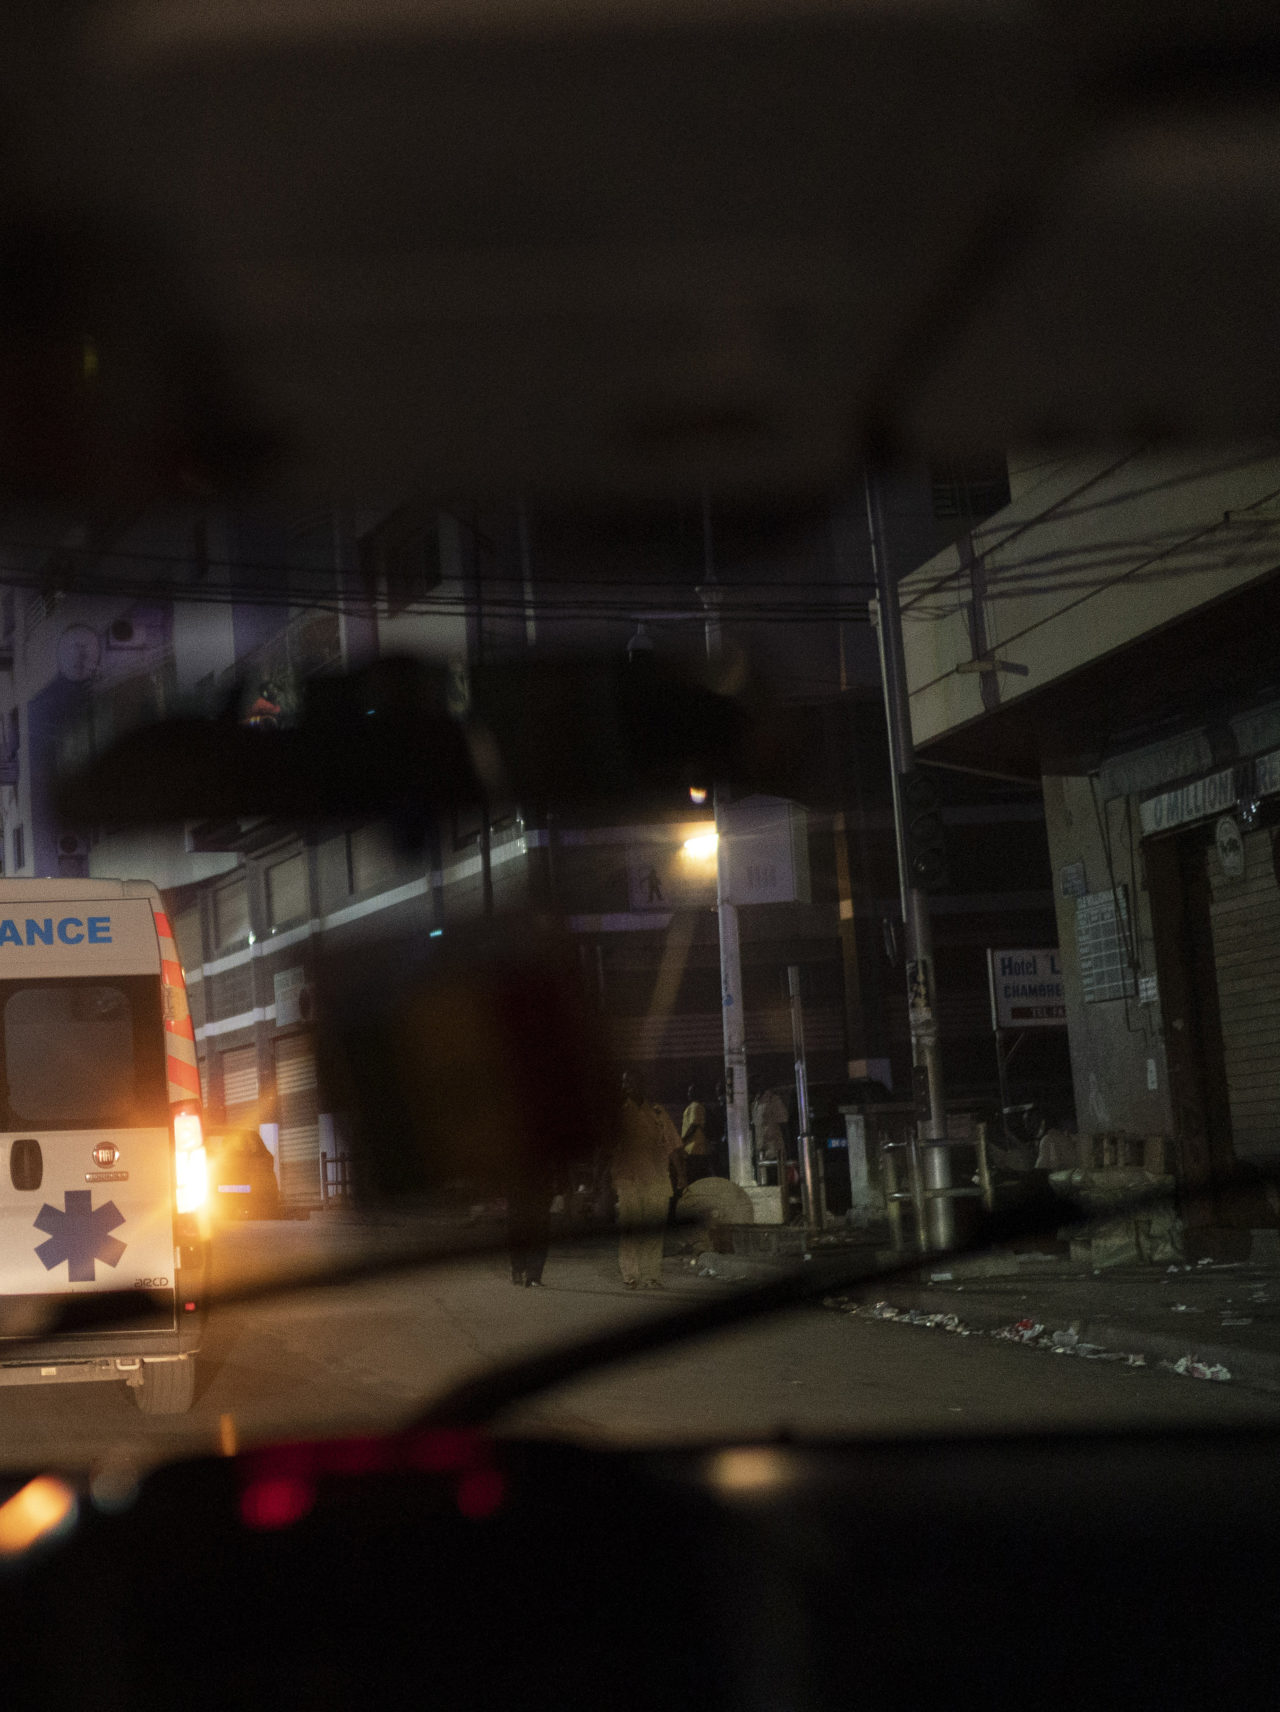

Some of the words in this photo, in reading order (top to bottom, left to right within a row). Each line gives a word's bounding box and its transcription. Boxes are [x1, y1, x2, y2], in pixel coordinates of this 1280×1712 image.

[1000, 955, 1037, 976] Hotel
[1003, 983, 1064, 998] CHAMBRE
[98, 1149, 114, 1163] FIAT
